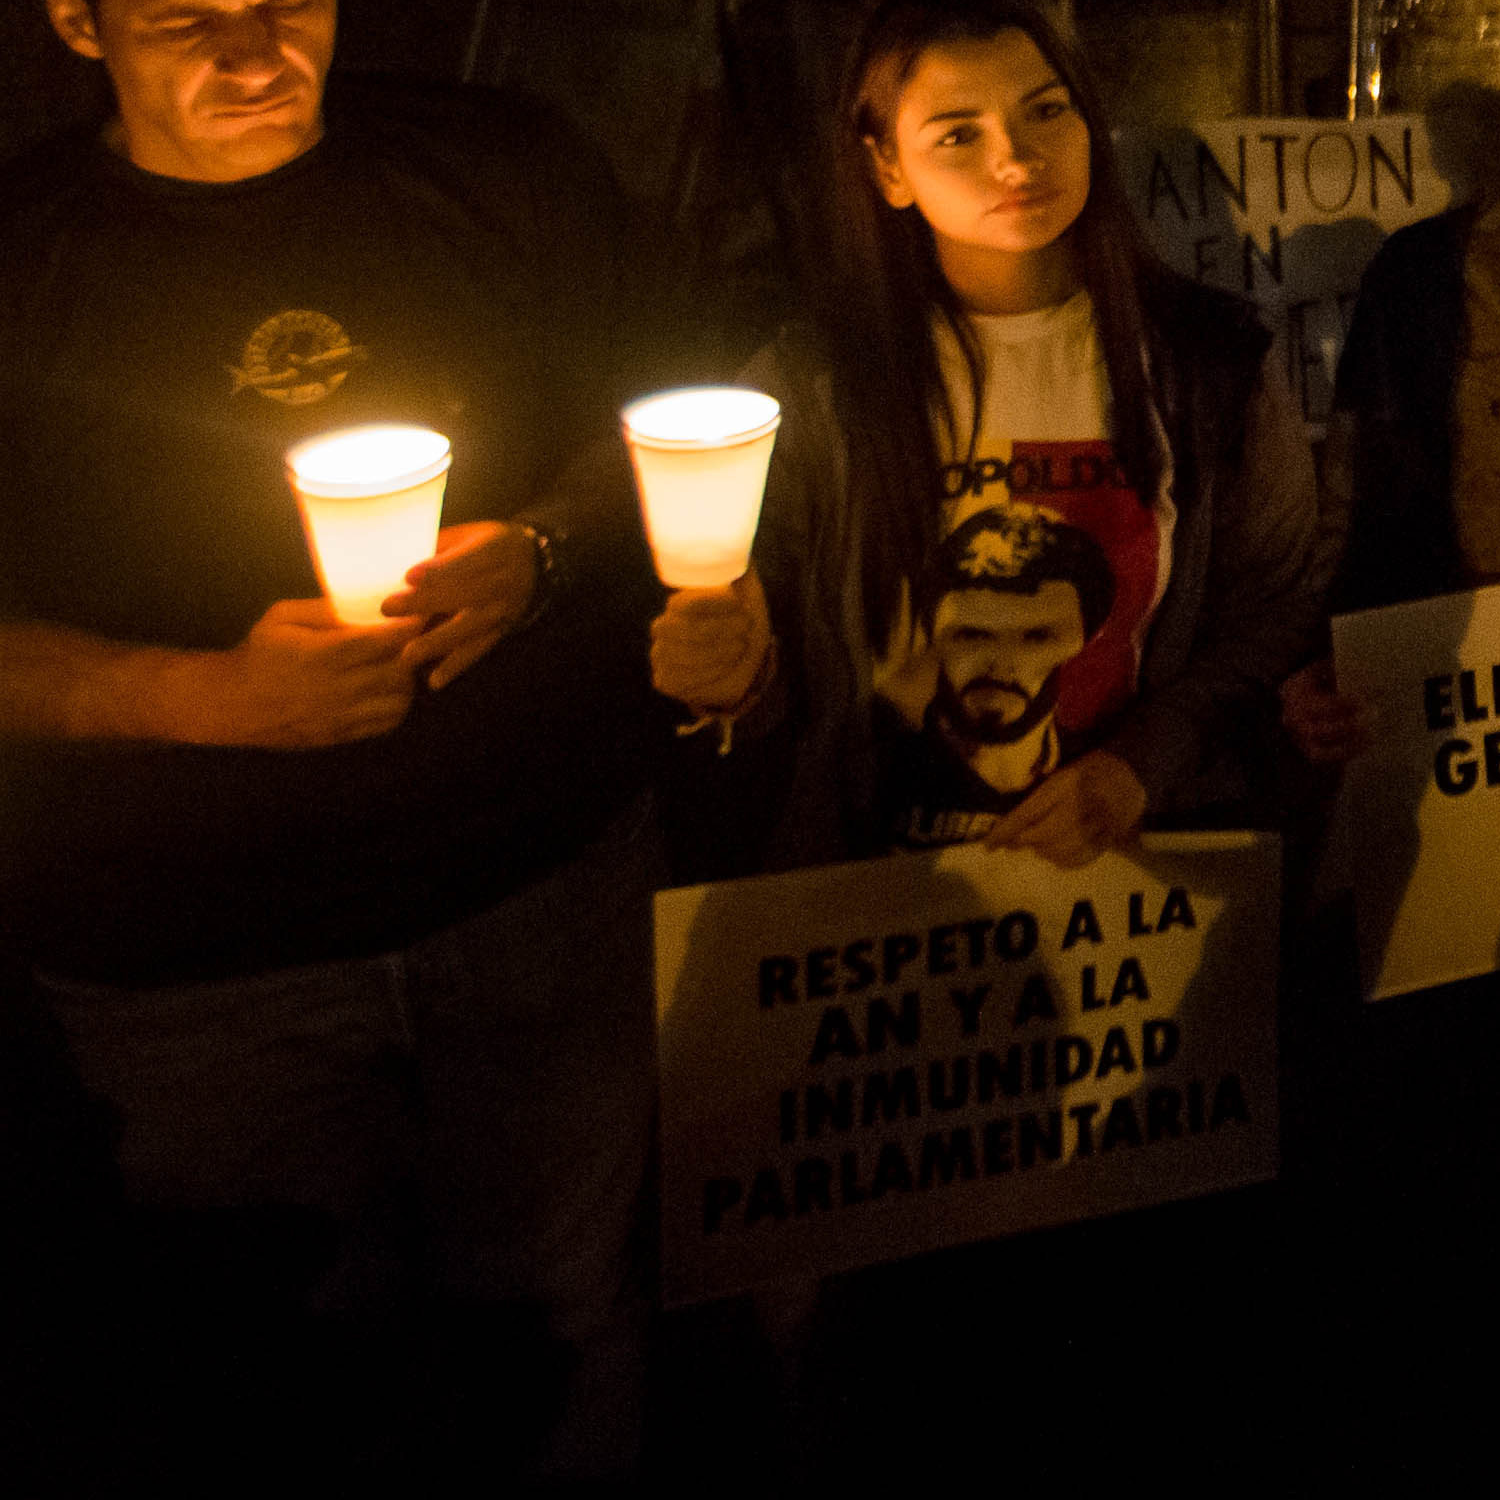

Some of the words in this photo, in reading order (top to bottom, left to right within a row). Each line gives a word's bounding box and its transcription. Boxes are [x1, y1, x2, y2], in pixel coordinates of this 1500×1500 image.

[1145, 127, 1416, 222] ANTON
[756, 909, 1041, 1011] RESPETO
[1061, 898, 1104, 951] A
[1126, 885, 1199, 937] LA
[808, 989, 923, 1068] AN
[950, 982, 996, 1038] Y
[1013, 972, 1061, 1031] A
[1079, 956, 1152, 1015] LA
[776, 1018, 1184, 1146] INMUNIDAD
[700, 1072, 1256, 1236] PARLAMENTARIA
